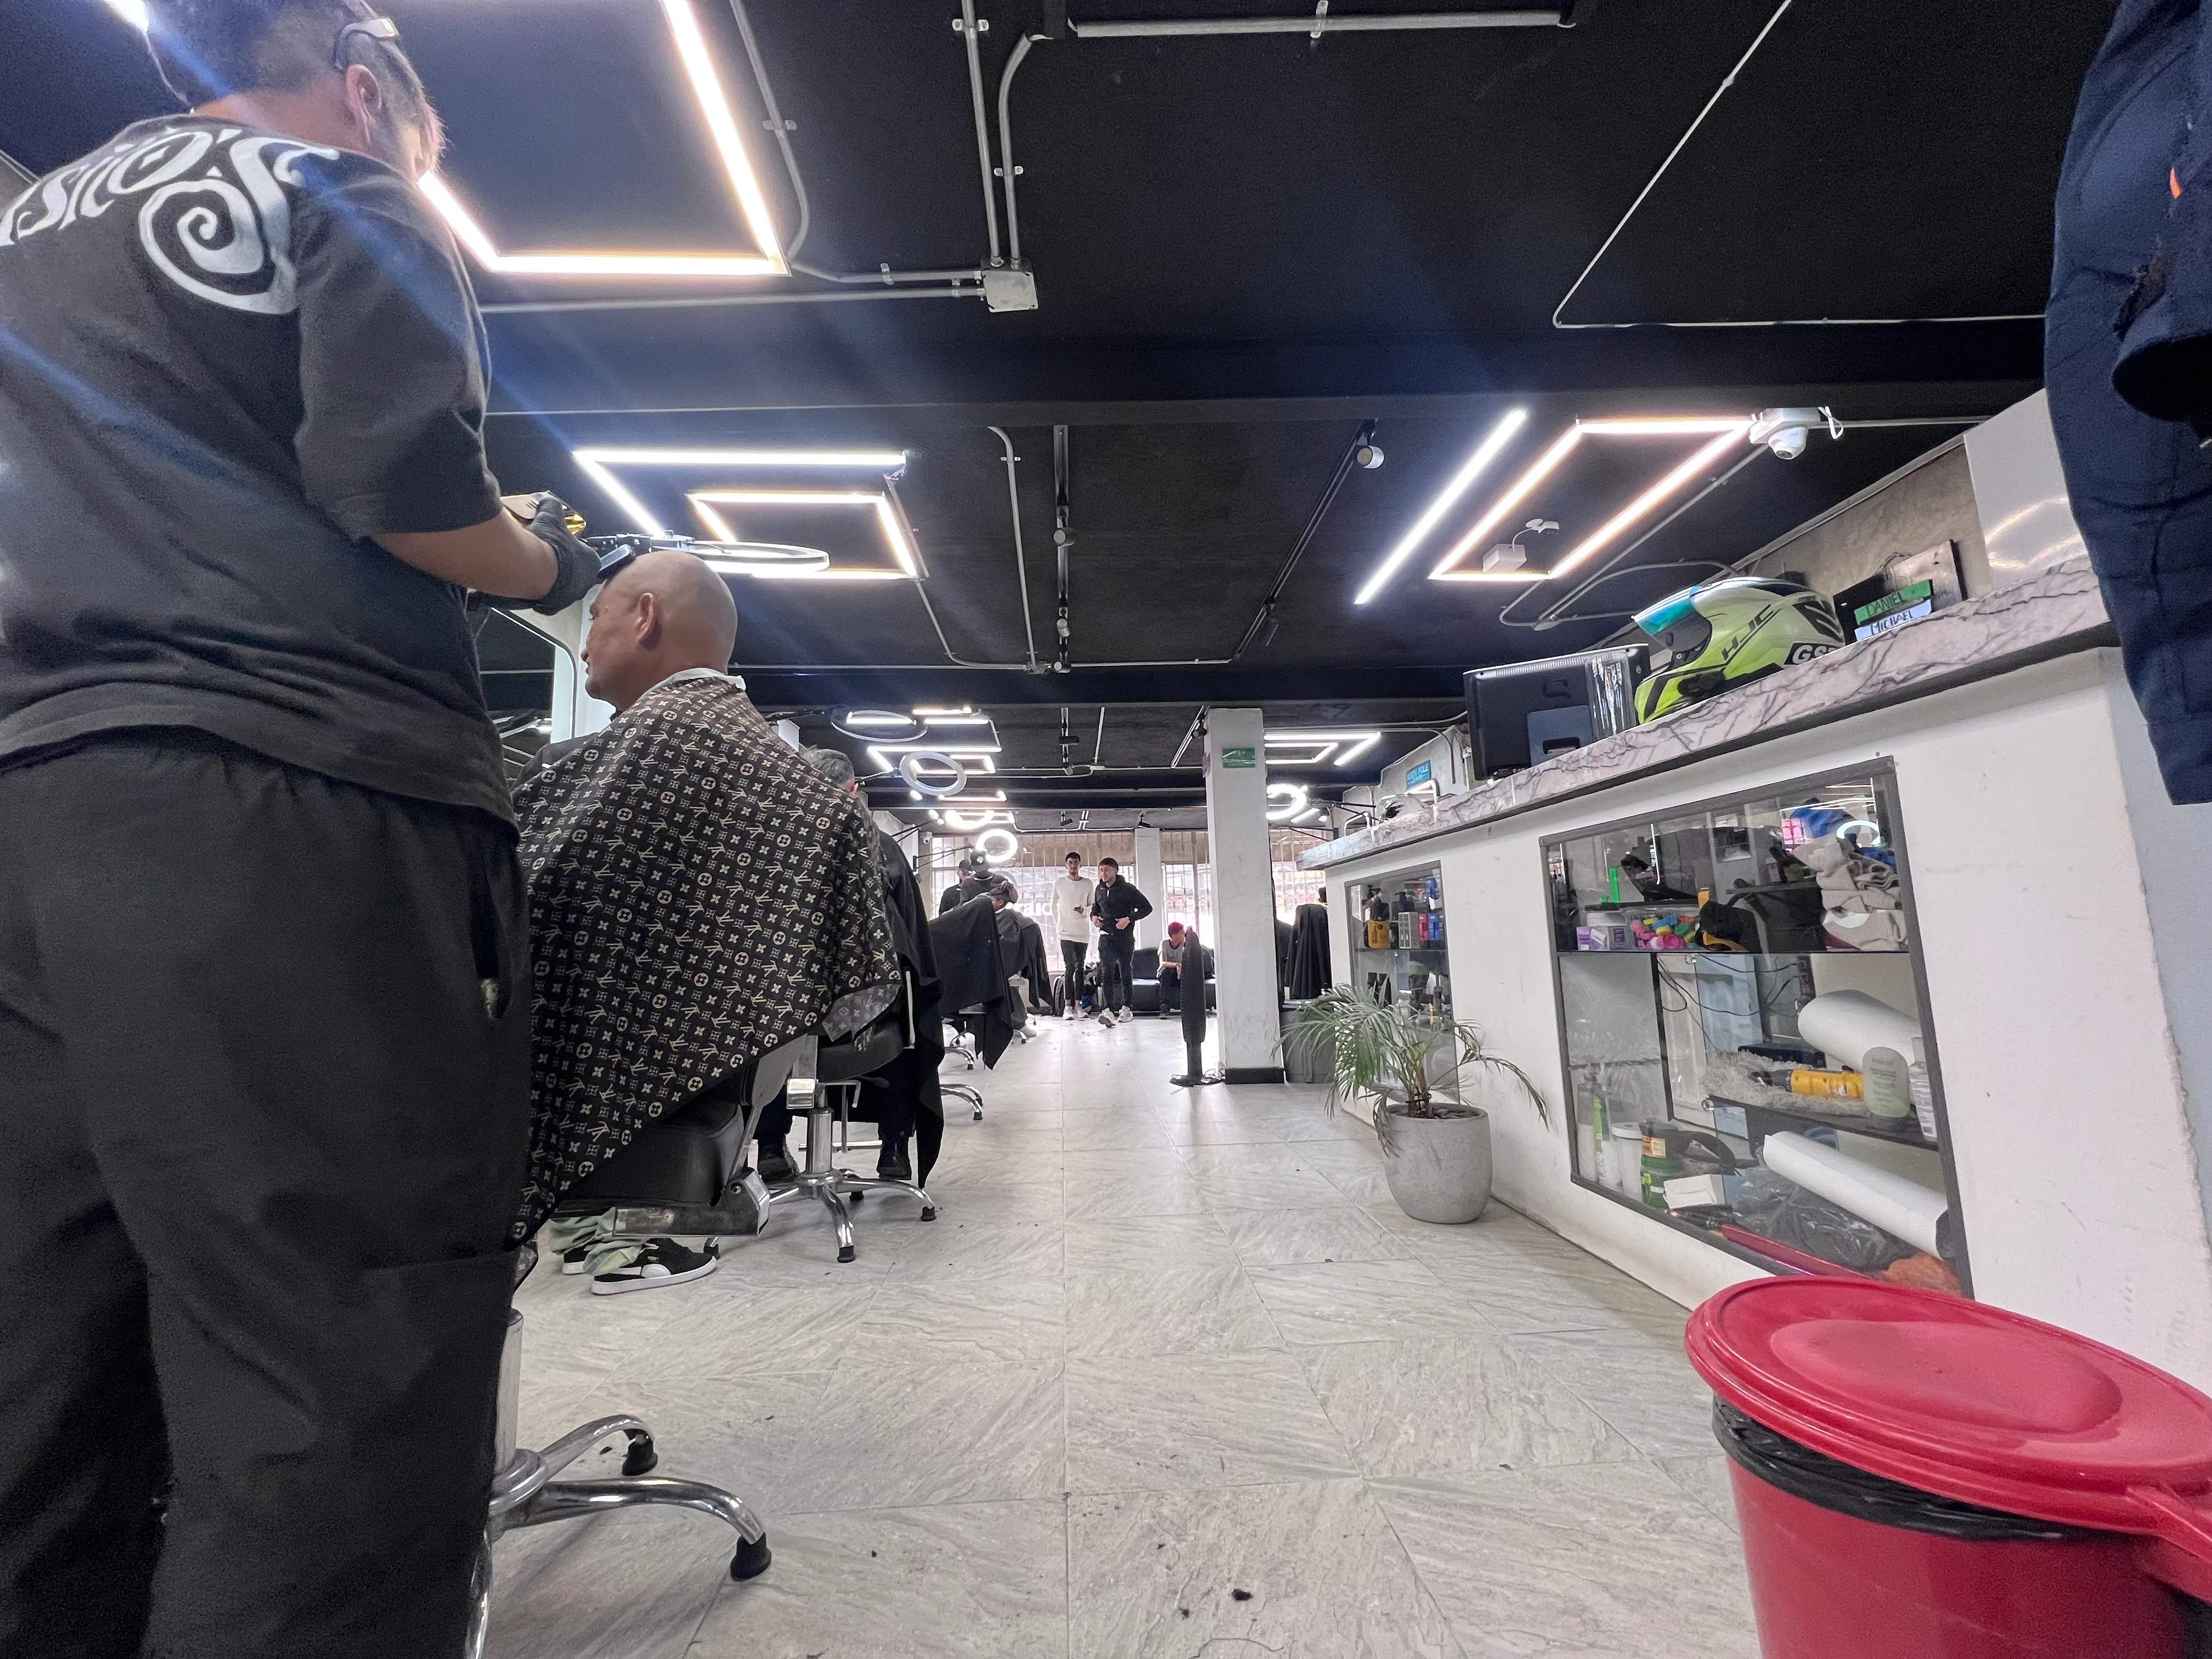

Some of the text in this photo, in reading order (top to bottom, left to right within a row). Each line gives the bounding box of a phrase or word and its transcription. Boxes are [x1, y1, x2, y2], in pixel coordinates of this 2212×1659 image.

[1866, 591, 1904, 616] DANIEL
[1722, 604, 1773, 661] HJC
[1870, 610, 1913, 635] MICHAEL
